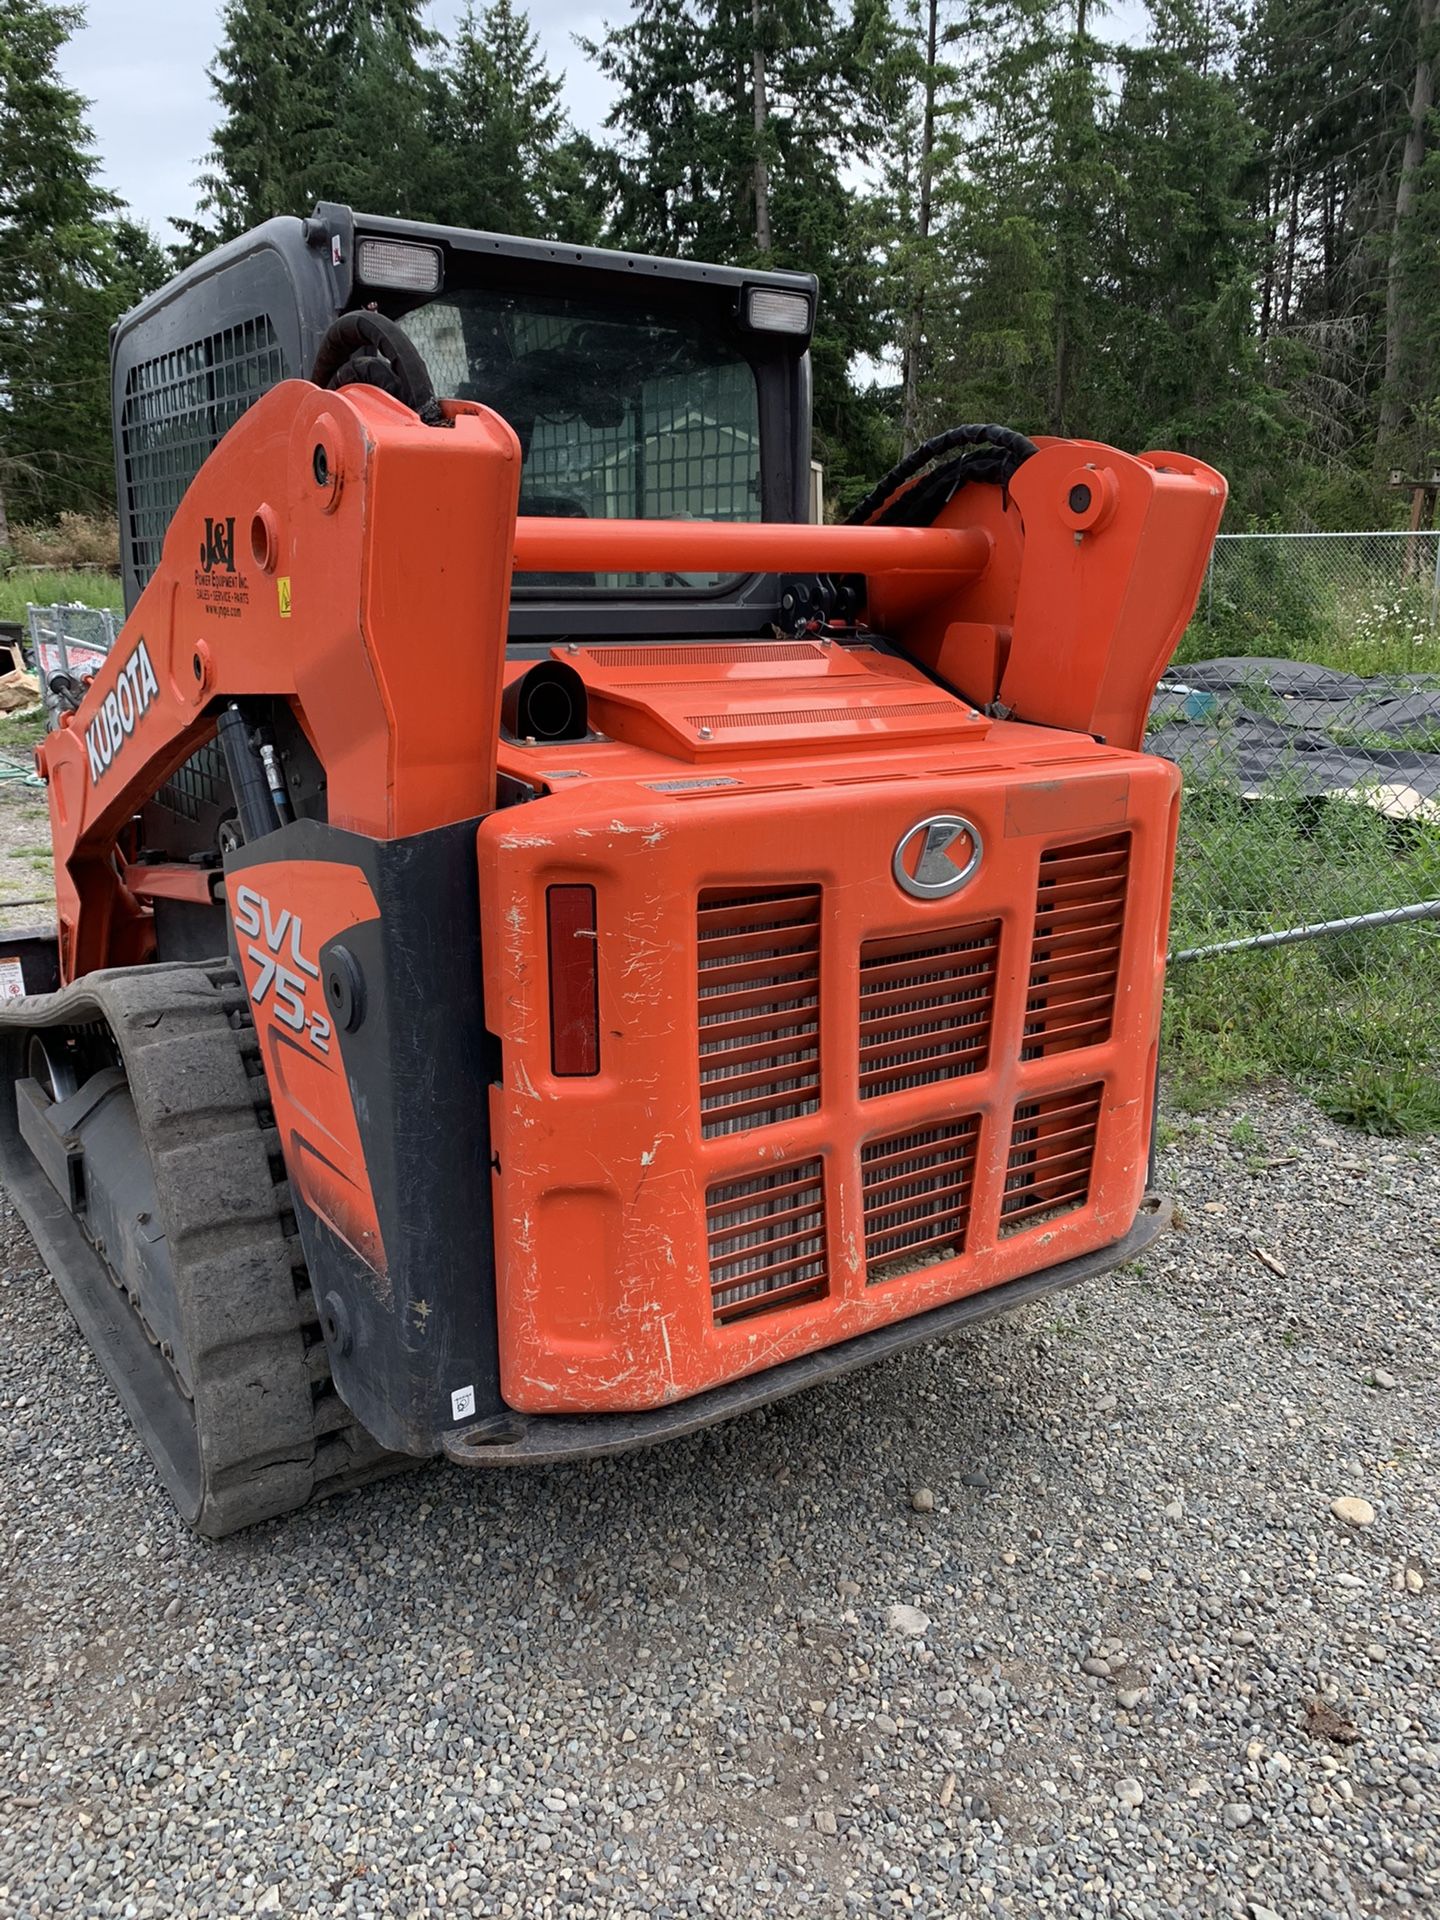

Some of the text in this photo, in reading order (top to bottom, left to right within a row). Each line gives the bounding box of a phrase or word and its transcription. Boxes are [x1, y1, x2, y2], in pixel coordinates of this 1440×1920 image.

[200, 516, 236, 573] J&I
[85, 639, 159, 784] KUBOTA
[234, 884, 320, 980] SVL
